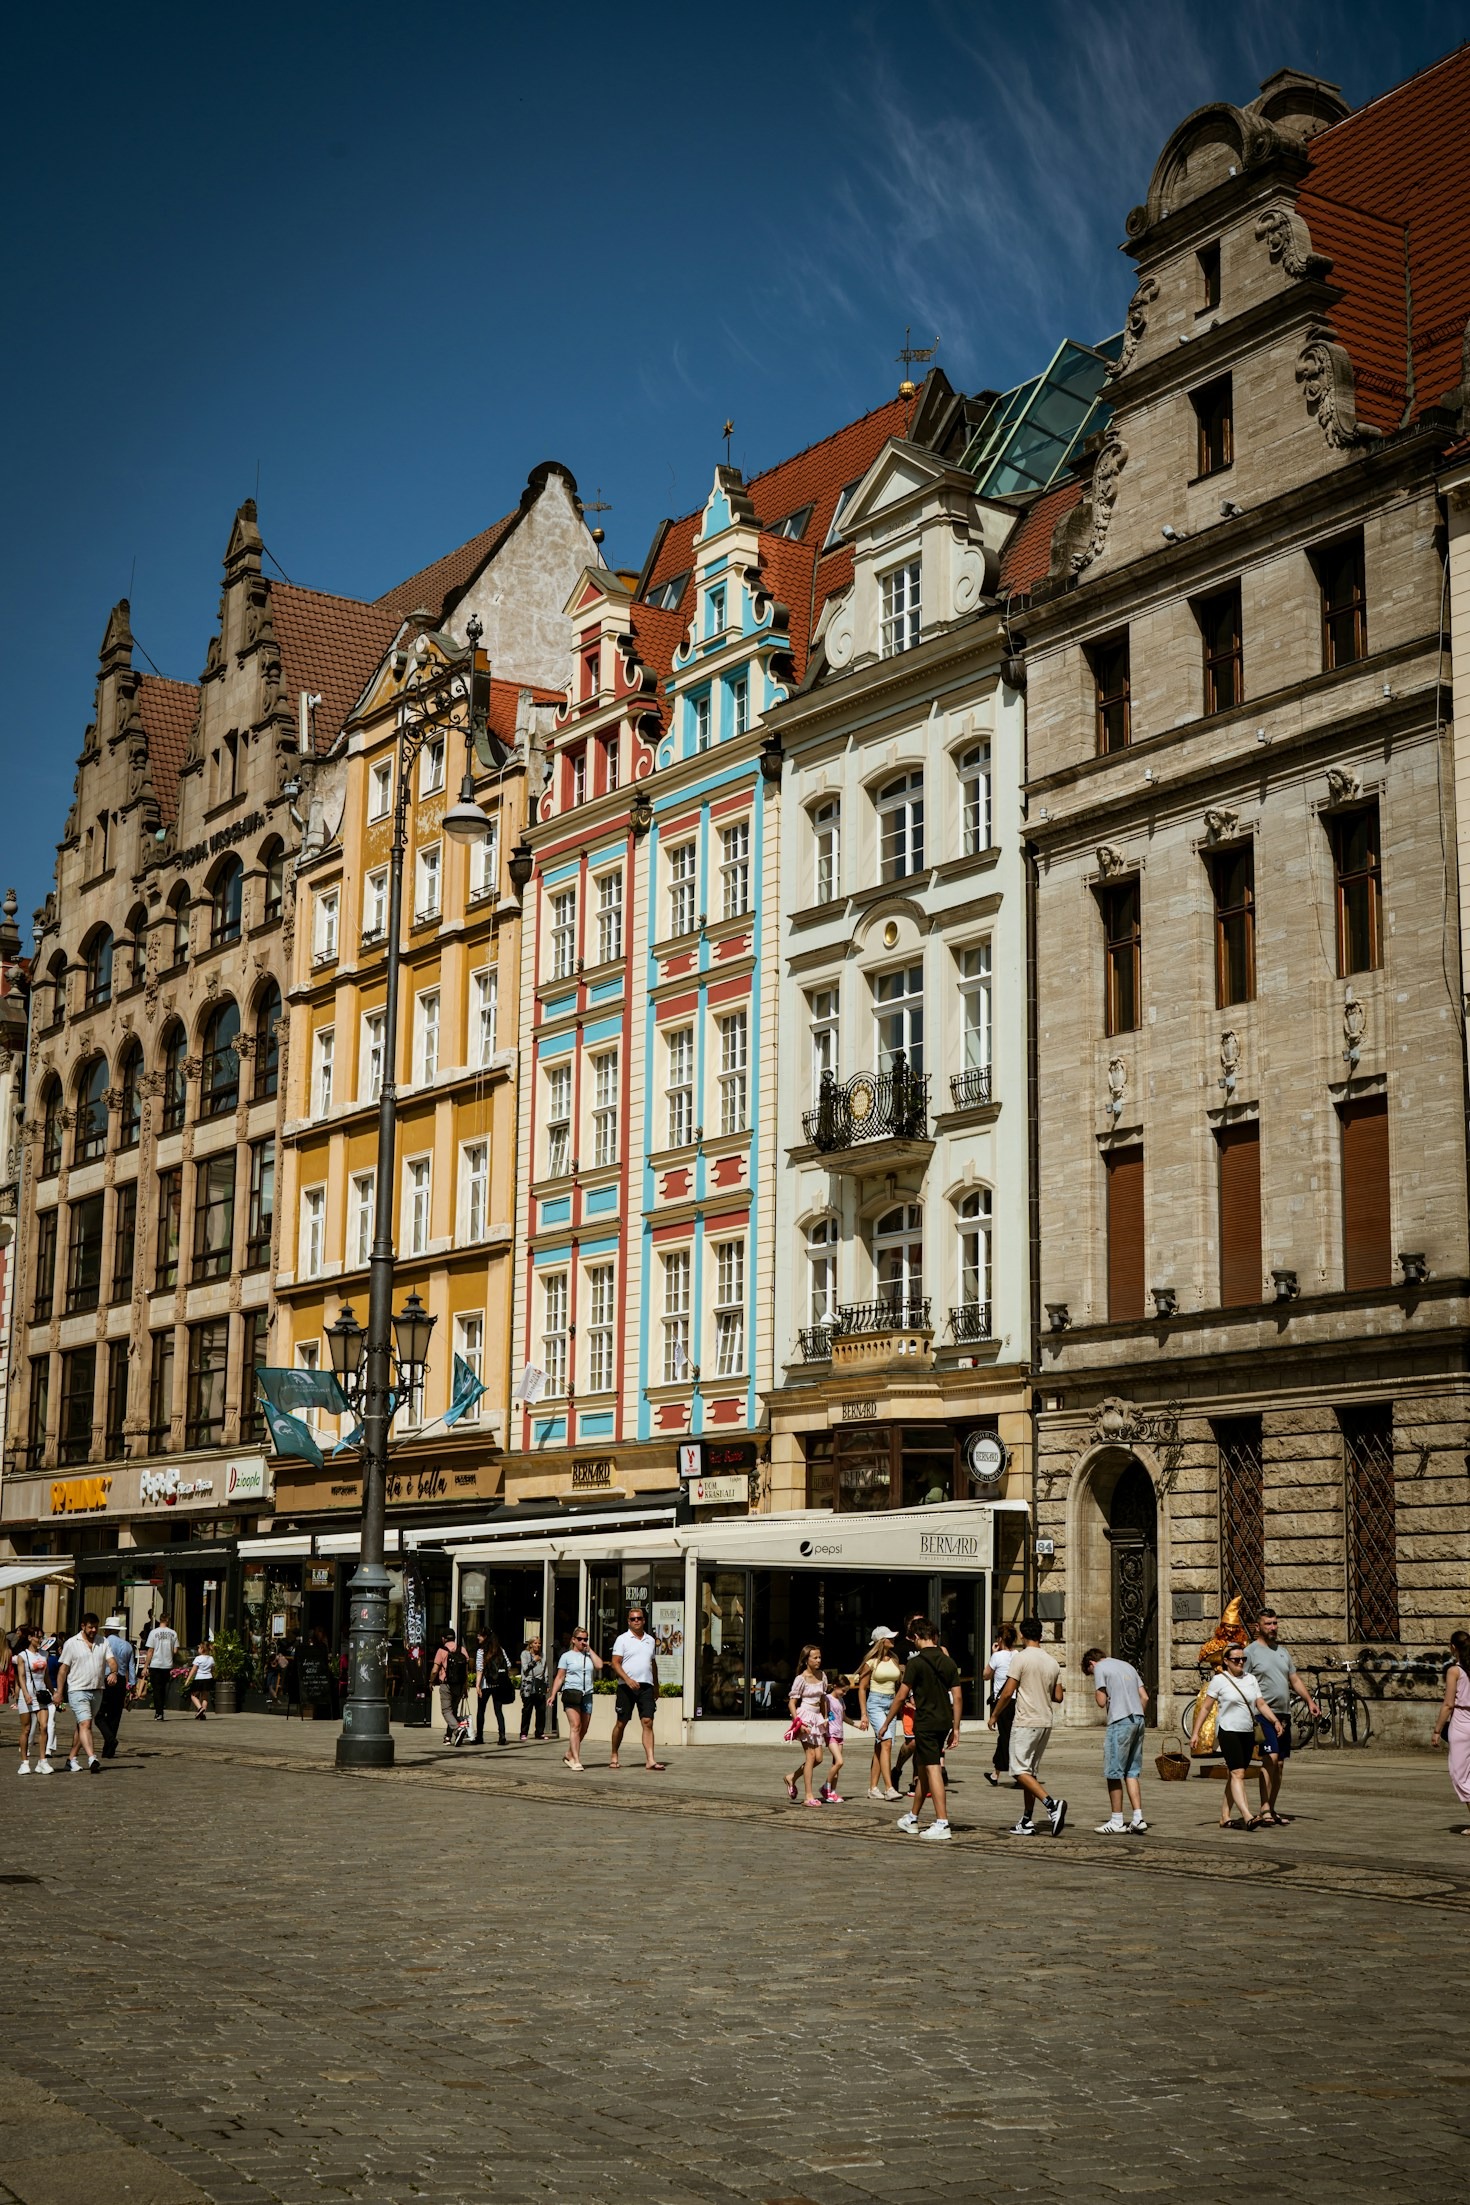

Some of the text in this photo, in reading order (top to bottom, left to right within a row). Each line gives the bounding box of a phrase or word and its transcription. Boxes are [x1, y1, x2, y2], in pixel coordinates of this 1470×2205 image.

[842, 1402, 876, 1419] BERNARD
[572, 1462, 610, 1482] BERNARD
[418, 1466, 447, 1499] bella
[704, 1482, 717, 1491] DOM
[814, 1544, 843, 1556] pepsi
[921, 1536, 978, 1555] BERNARD
